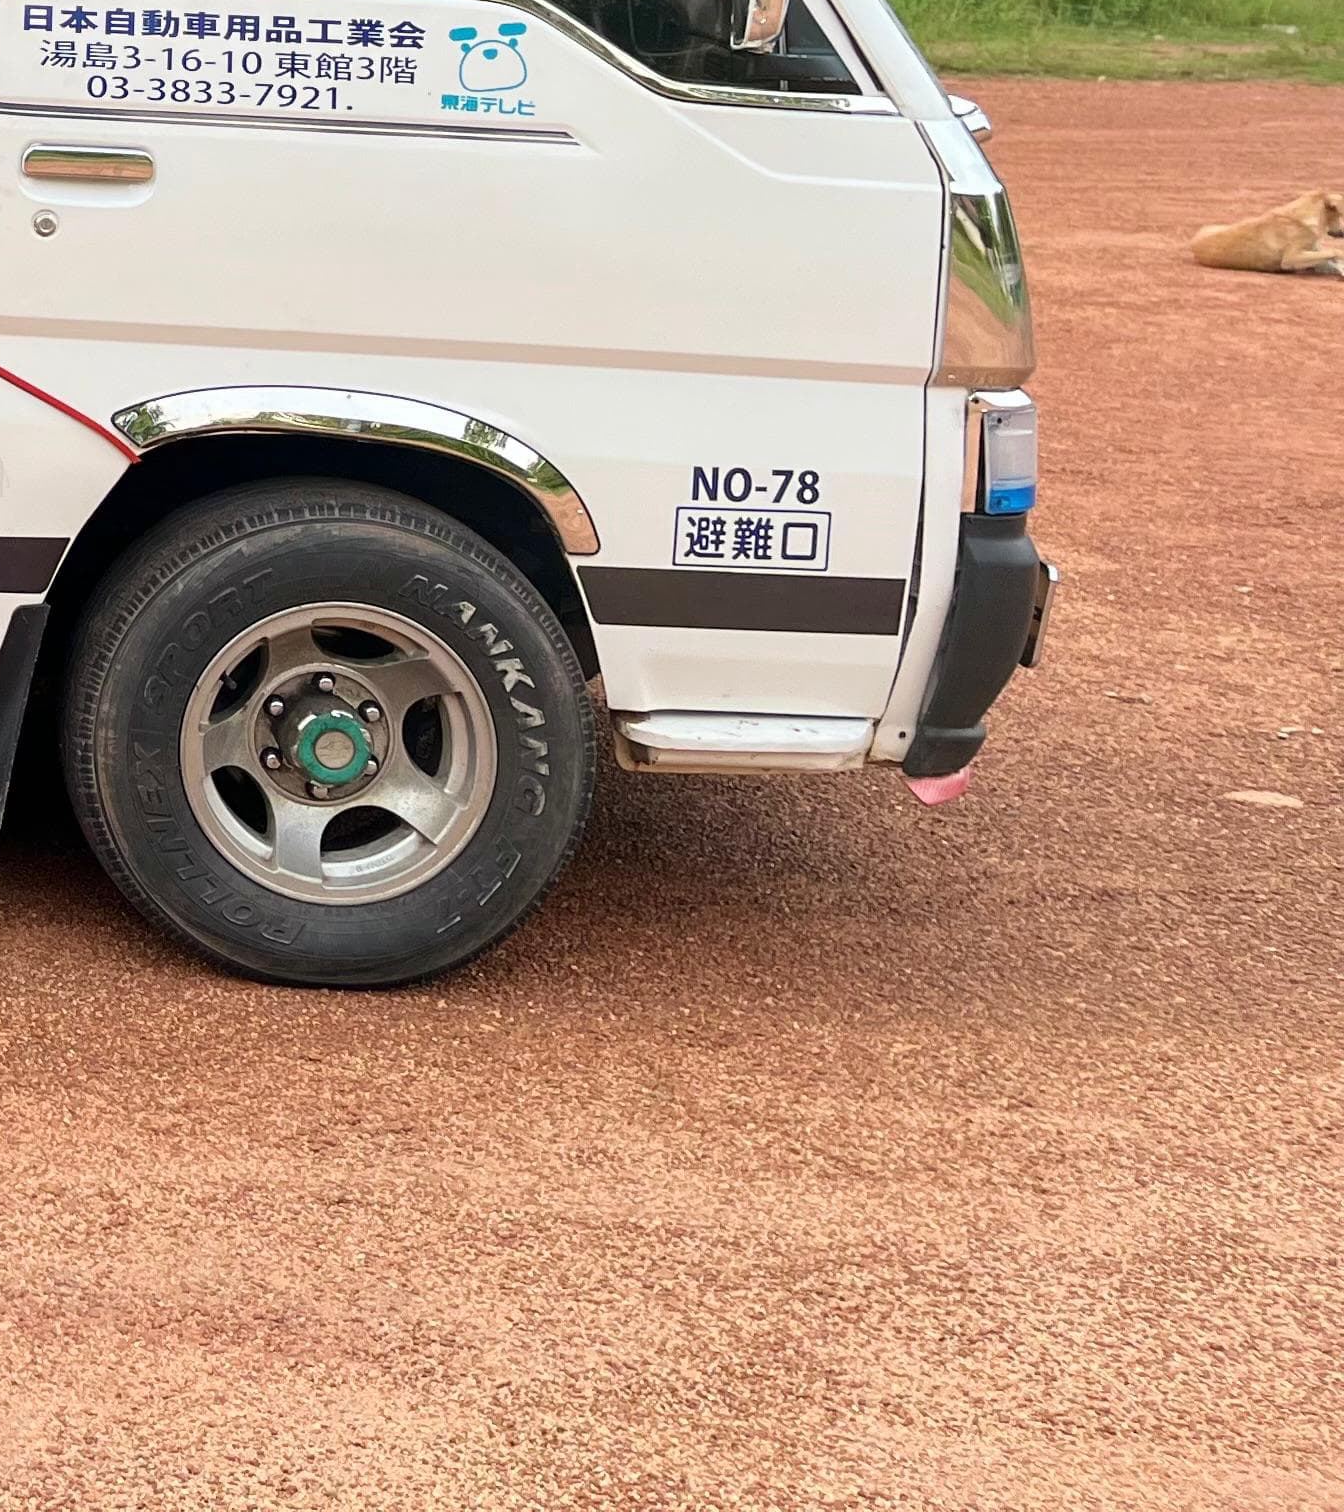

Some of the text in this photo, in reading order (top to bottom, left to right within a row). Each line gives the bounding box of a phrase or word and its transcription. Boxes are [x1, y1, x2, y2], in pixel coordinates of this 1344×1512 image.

[22, 4, 426, 50] 日本自動車用品工業会
[39, 39, 419, 86] 湯島3-16-10 東館3階
[86, 74, 354, 111] 03-3833-7921.
[691, 466, 820, 505] NO-78
[683, 516, 818, 561] 避難口
[398, 574, 550, 817] NANKANG
